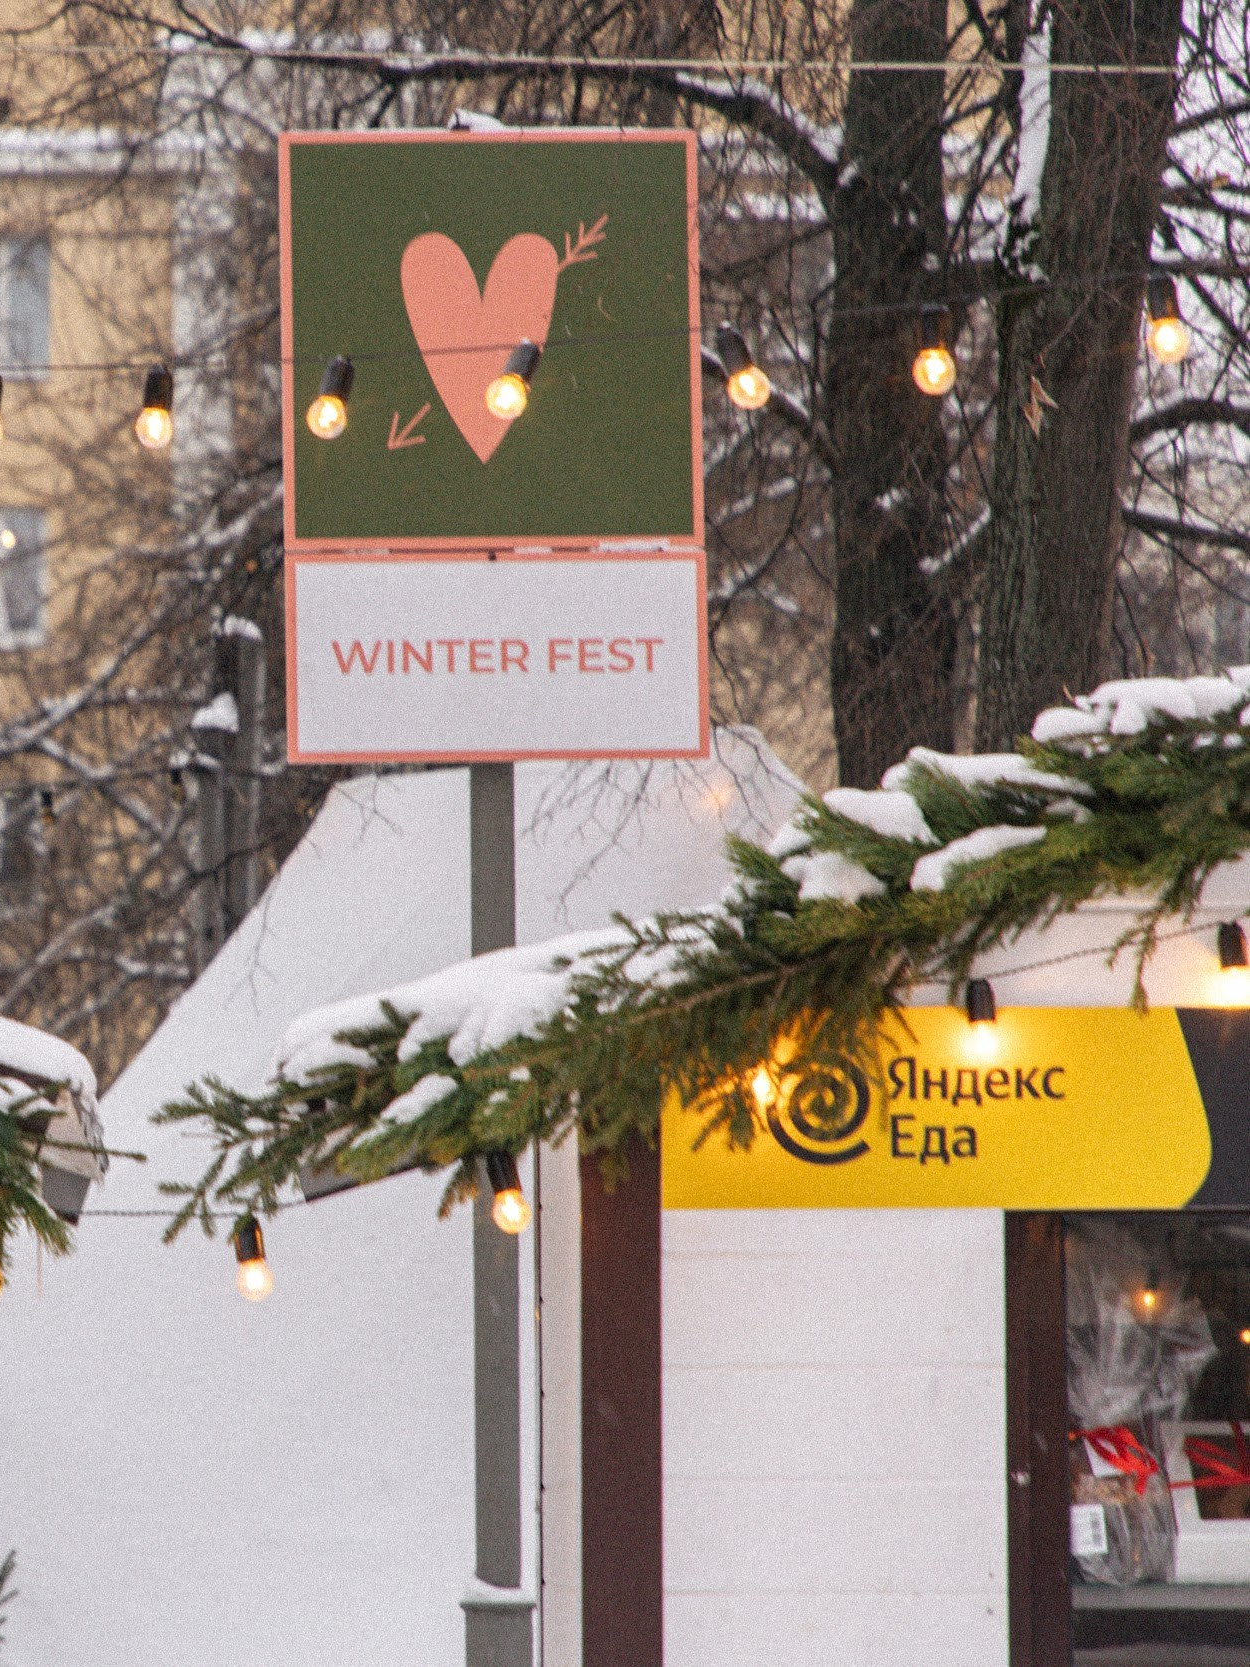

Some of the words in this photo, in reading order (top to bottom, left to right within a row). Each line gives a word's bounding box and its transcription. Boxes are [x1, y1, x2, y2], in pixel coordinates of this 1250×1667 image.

[331, 638, 531, 674] WINTER
[548, 637, 664, 673] FEST
[886, 1056, 1066, 1106] Яндекс
[889, 1113, 979, 1166] Еда
